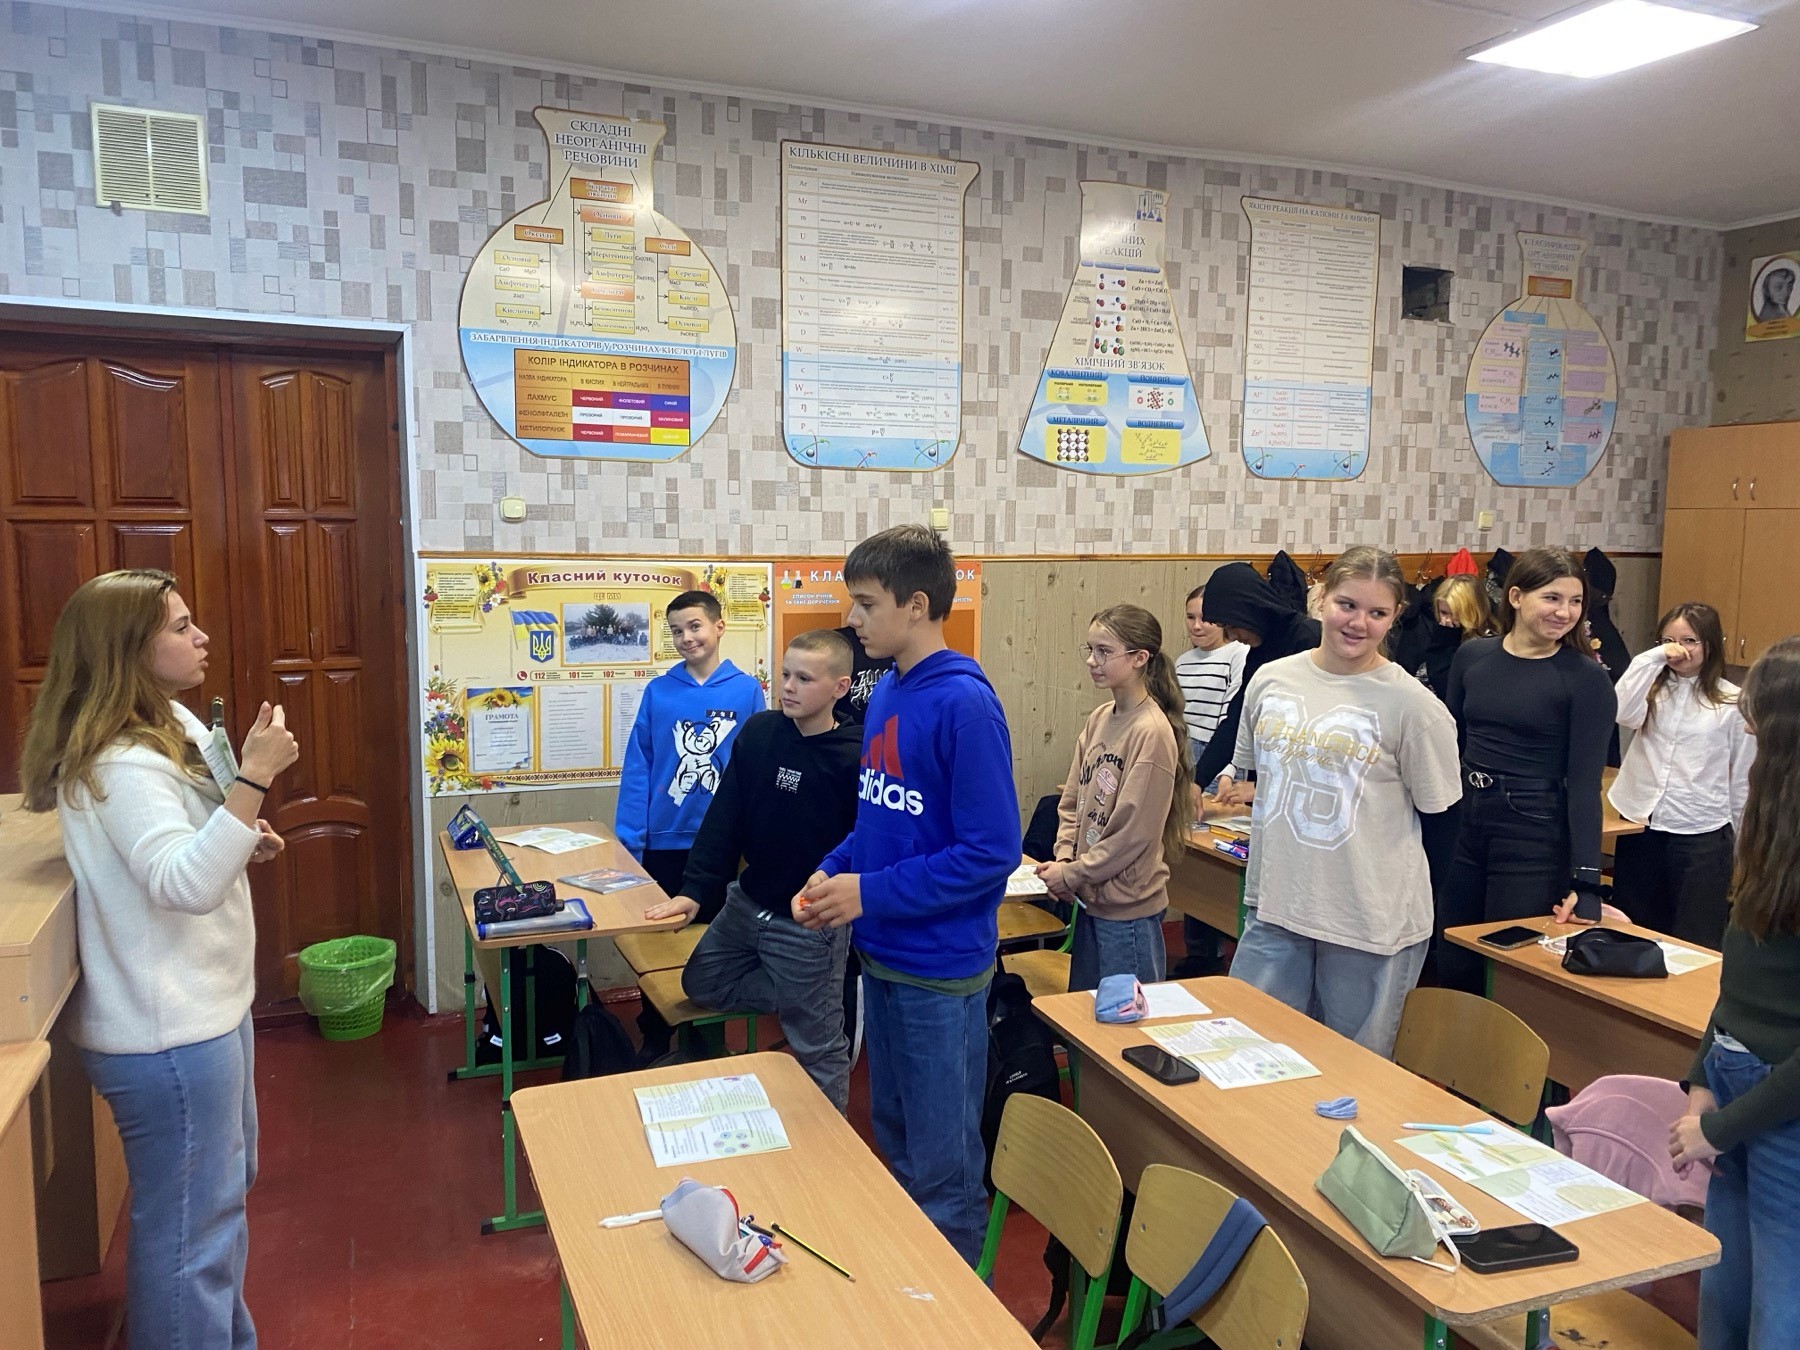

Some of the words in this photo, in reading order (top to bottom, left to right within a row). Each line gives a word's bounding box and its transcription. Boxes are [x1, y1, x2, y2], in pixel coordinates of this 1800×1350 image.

[570, 120, 632, 138] СКЛАДНІ
[555, 134, 648, 154] НЕОРГАНІЧНІ
[565, 150, 639, 168] РЕЧОВИНИ
[789, 146, 850, 162] КІЛЬКІСНІ
[852, 154, 917, 171] ВЕЛИЧИНИ
[920, 162, 927, 172] В
[930, 162, 956, 176] ХІМІЇ
[471, 332, 538, 346] ЗАБАРВЛЕННЯ
[540, 338, 602, 350] ІНДИКАТОРІВ
[612, 342, 660, 354] РОЗЧИНАХ
[661, 346, 696, 356] КИСЛОТ
[703, 350, 728, 359] ЛУГІВ
[528, 356, 556, 366] КОЛІР
[559, 358, 618, 370] ІНДИКАТОРА
[620, 362, 628, 371] В
[630, 363, 680, 374] РОЗЧИНАХ
[1074, 356, 1125, 369] ХІМІЧНИЙ
[1126, 358, 1165, 371] ЗВ'ЯЗОК
[1051, 369, 1103, 380] КОВАЛЕНТНИЙ
[527, 393, 557, 402] ЛАХМУС
[527, 570, 606, 585] Класний
[613, 572, 682, 586] куточок
[634, 670, 646, 678] 103
[485, 712, 518, 721] ГРАМОТА
[858, 768, 924, 816] didas
